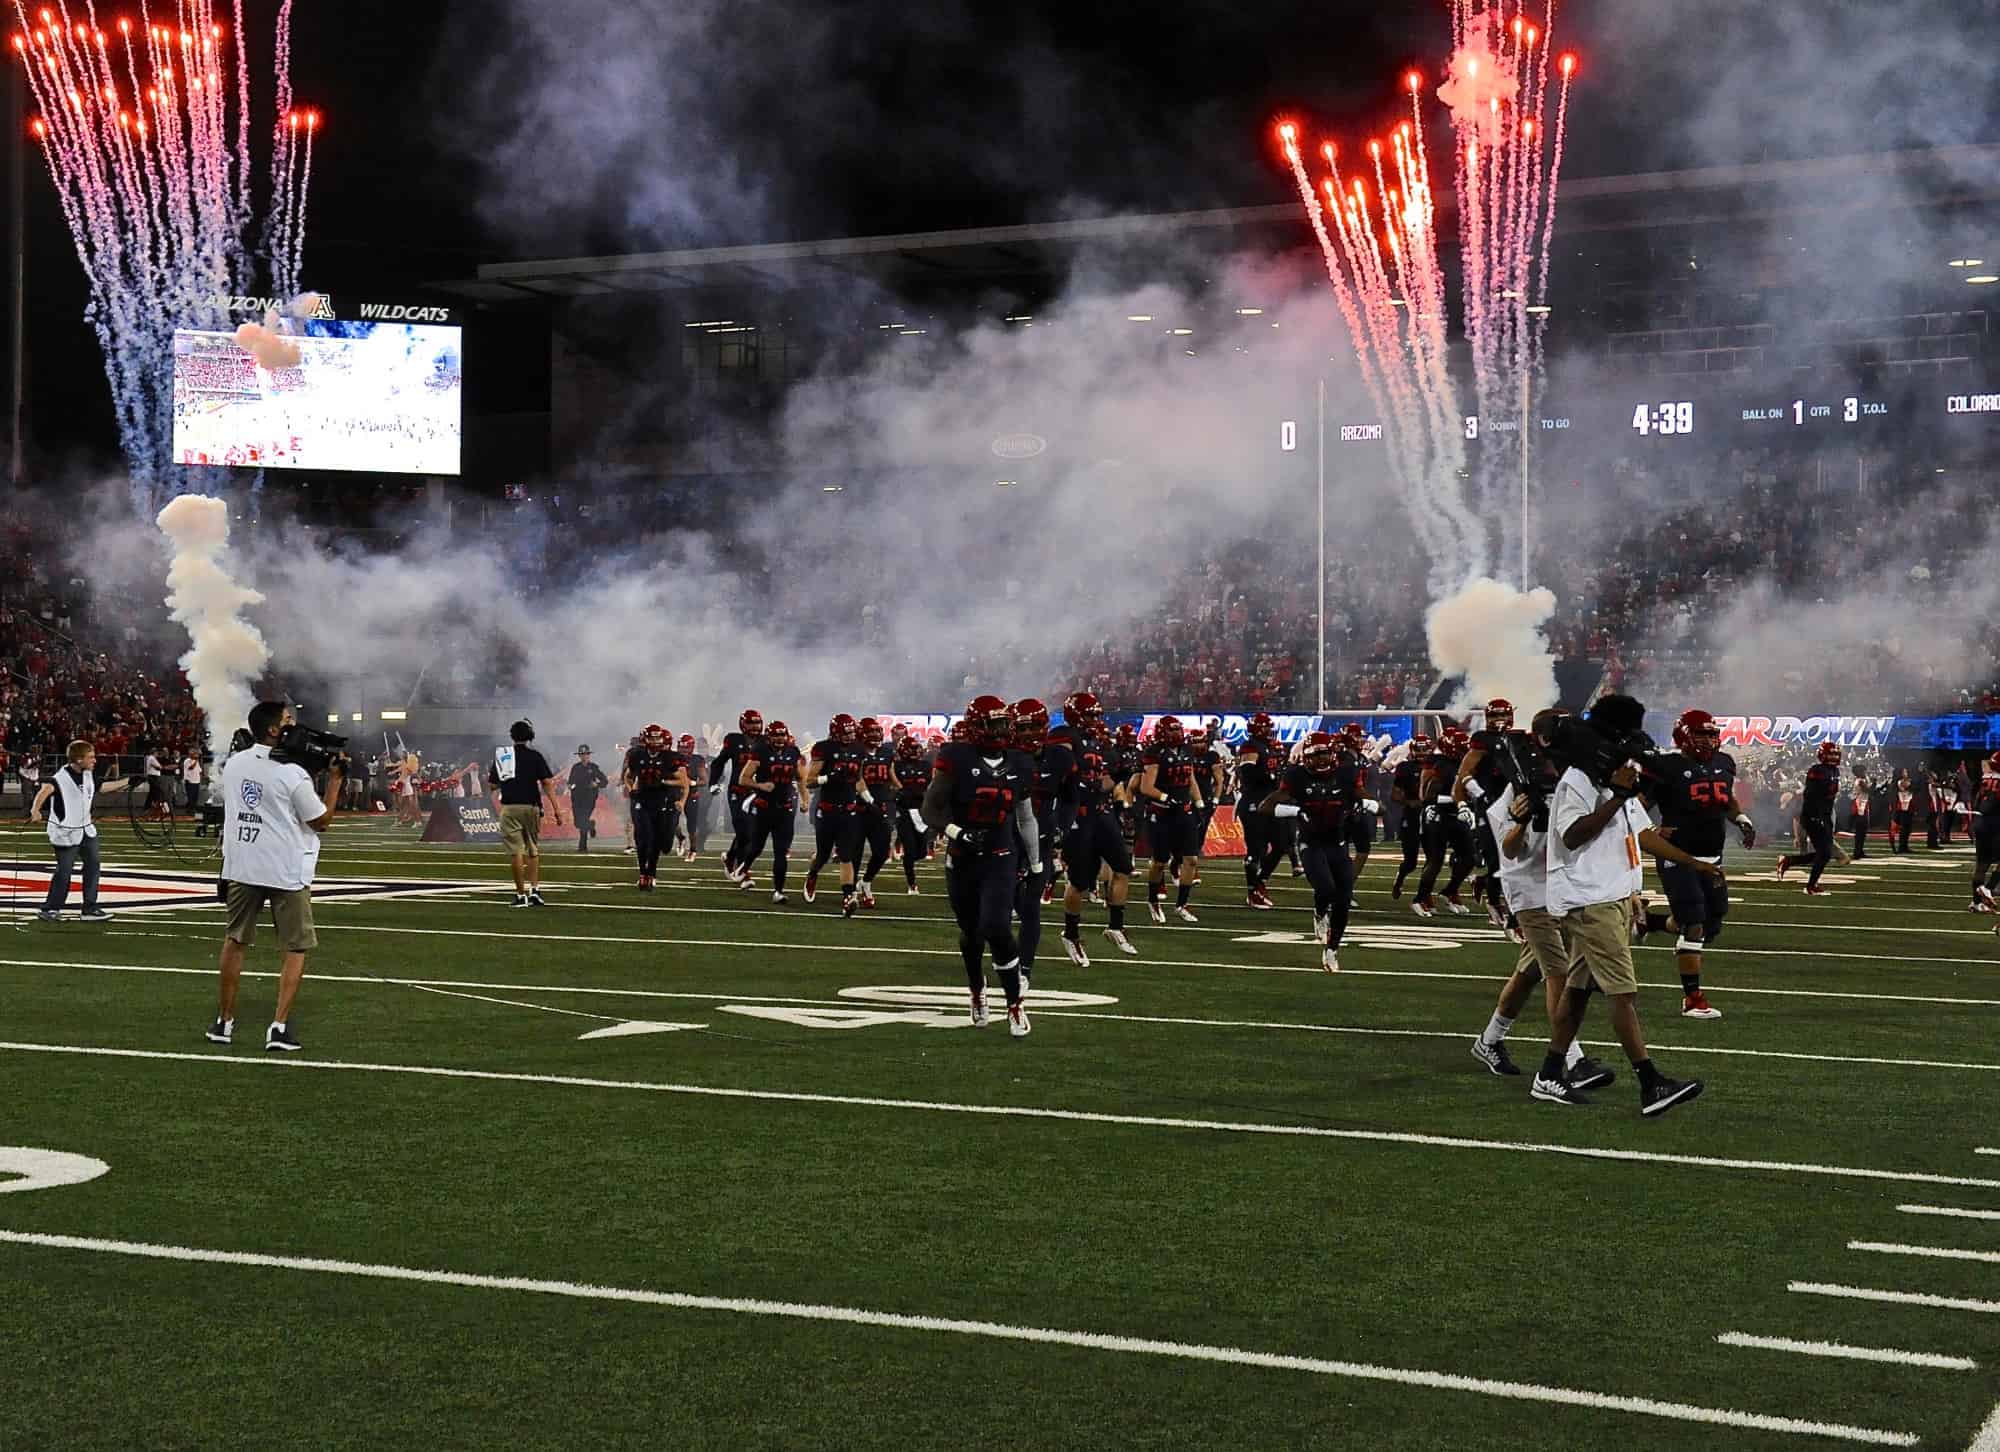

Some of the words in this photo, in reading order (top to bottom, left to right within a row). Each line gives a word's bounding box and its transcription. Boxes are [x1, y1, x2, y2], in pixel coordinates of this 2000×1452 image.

[360, 304, 449, 321] WILDCATS
[1742, 409, 1767, 419] BALL
[1769, 408, 1784, 418] ON
[1793, 401, 1803, 425] 1
[1810, 406, 1830, 416] QTR
[1844, 398, 1858, 422] 3
[1541, 420, 1554, 429] TO
[1556, 419, 1570, 428] GO
[1632, 402, 1693, 435] 4:39
[1341, 425, 1382, 440] ARIZONA
[1465, 416, 1478, 439] 3
[238, 812, 263, 824] MEDIA
[459, 806, 490, 819] Game
[238, 827, 260, 843] 137
